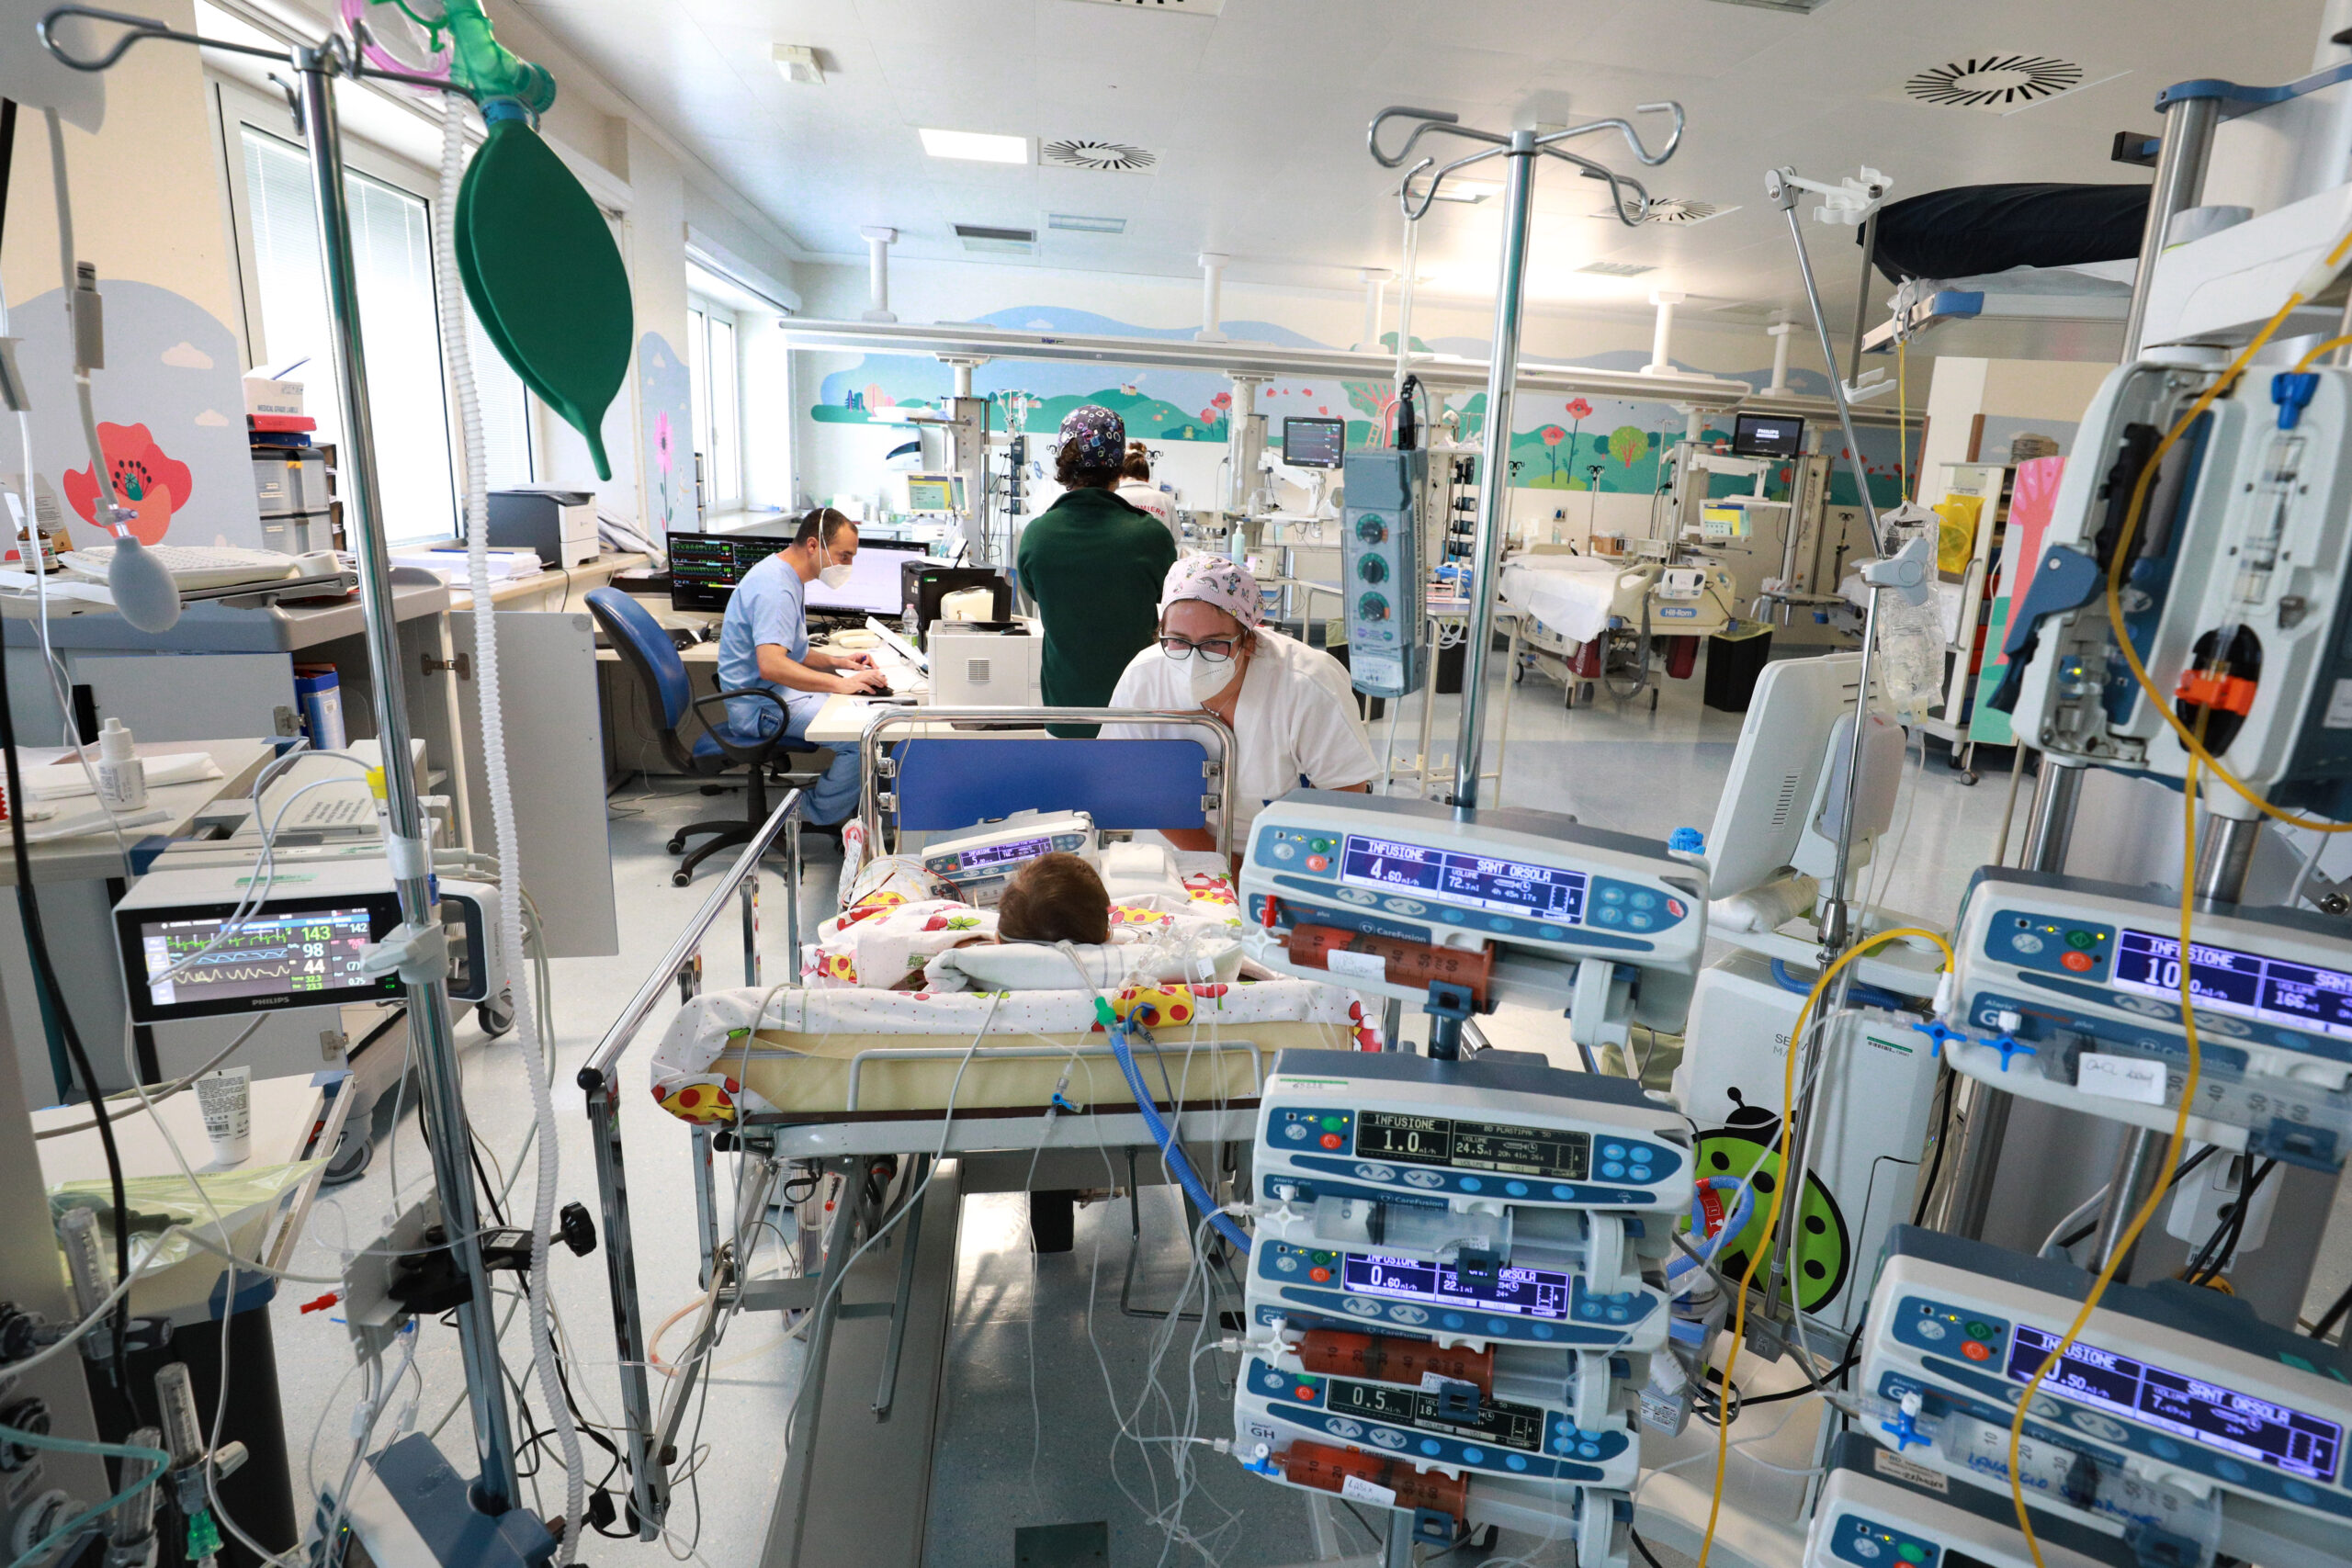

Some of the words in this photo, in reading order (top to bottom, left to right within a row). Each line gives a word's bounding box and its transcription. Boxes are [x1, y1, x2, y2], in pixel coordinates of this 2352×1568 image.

[257, 404, 274, 412] MEDICAL
[1367, 841, 1425, 862] INFUSIONE
[1452, 868, 1479, 880] VOLUME
[1476, 860, 1505, 874] SANT
[1510, 865, 1552, 883] ORSOLA
[301, 926, 331, 942] 143
[349, 922, 368, 933] 142
[1376, 927, 1426, 944] CareFusion
[303, 942, 324, 958] 98
[1393, 950, 1404, 964] 40
[2150, 939, 2235, 969] INFSIONE
[303, 959, 325, 974] 44
[305, 975, 322, 983] 32.3
[252, 996, 290, 1007] PHILIPS
[2166, 1075, 2185, 1091] 30
[2209, 1084, 2225, 1102] 40
[1374, 1114, 1436, 1130] INFUSIONE
[1384, 1130, 1419, 1153] 1.0
[1463, 1135, 1488, 1145] VOLUME
[1395, 1196, 1444, 1209] CareFusion
[1381, 1328, 1428, 1341] CareFusion
[1329, 1347, 1338, 1359] 10
[1352, 1349, 1363, 1362] 20
[2040, 1336, 2120, 1371] INUSIONE
[1404, 1356, 1413, 1369] 40
[1352, 1385, 1385, 1411] 0.5
[2187, 1381, 2226, 1404] SANT
[2231, 1396, 2290, 1427] ORSOLA
[1250, 1427, 1275, 1440] GH
[1984, 1431, 1999, 1446] 10
[1308, 1461, 1319, 1473] 10
[2052, 1455, 2068, 1472] 30
[1332, 1466, 1343, 1479] 20
